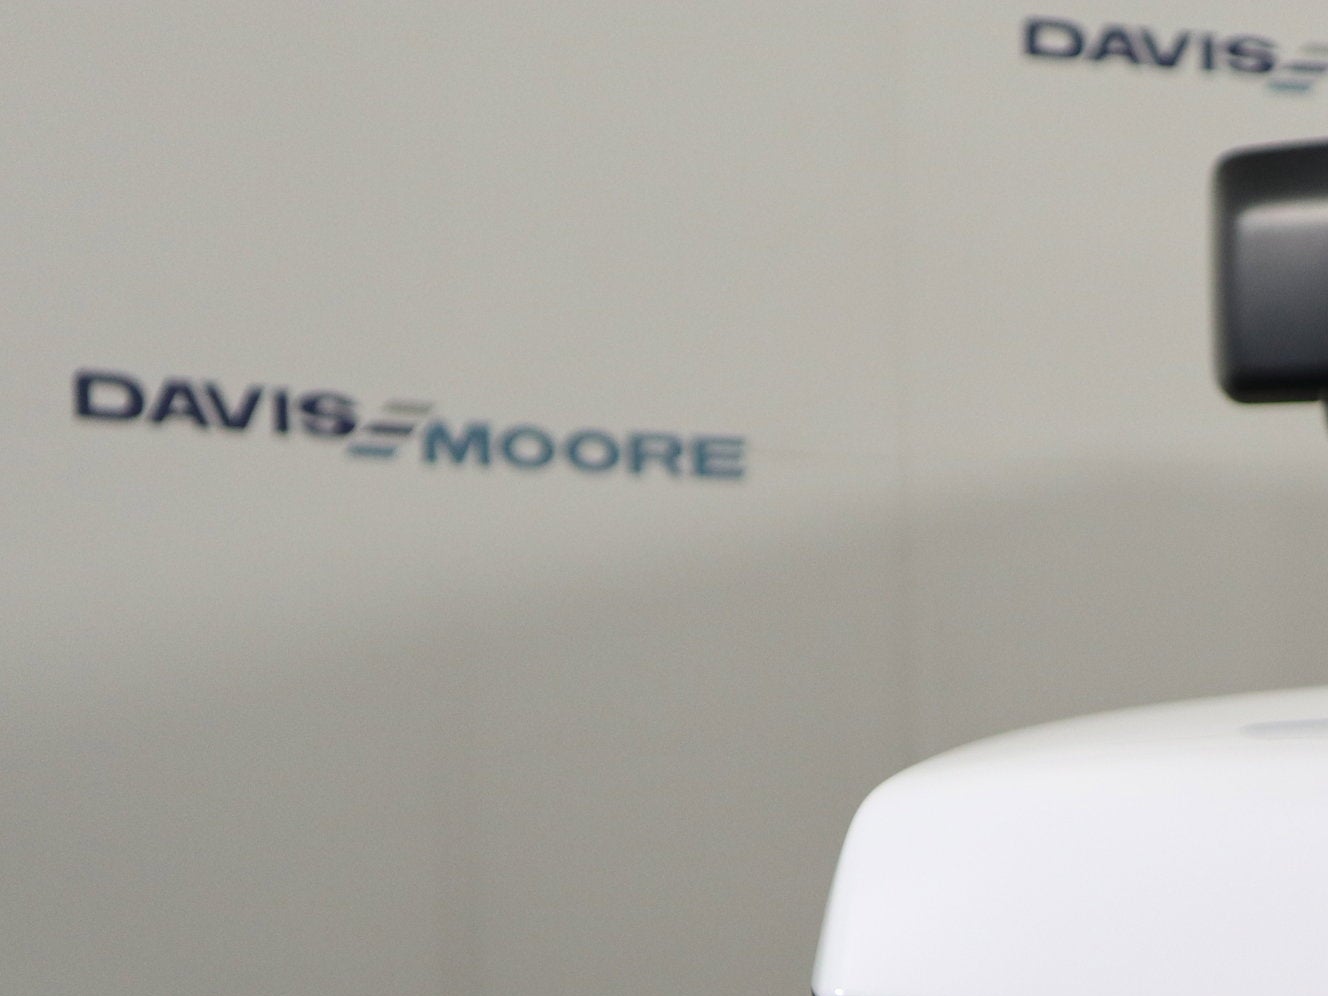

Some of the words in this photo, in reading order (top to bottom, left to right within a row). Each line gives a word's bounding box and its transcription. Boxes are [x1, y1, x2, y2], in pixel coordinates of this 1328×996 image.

[1024, 16, 1276, 73] DAVIS
[73, 368, 357, 437] DAVIS
[420, 420, 746, 479] MOORE
